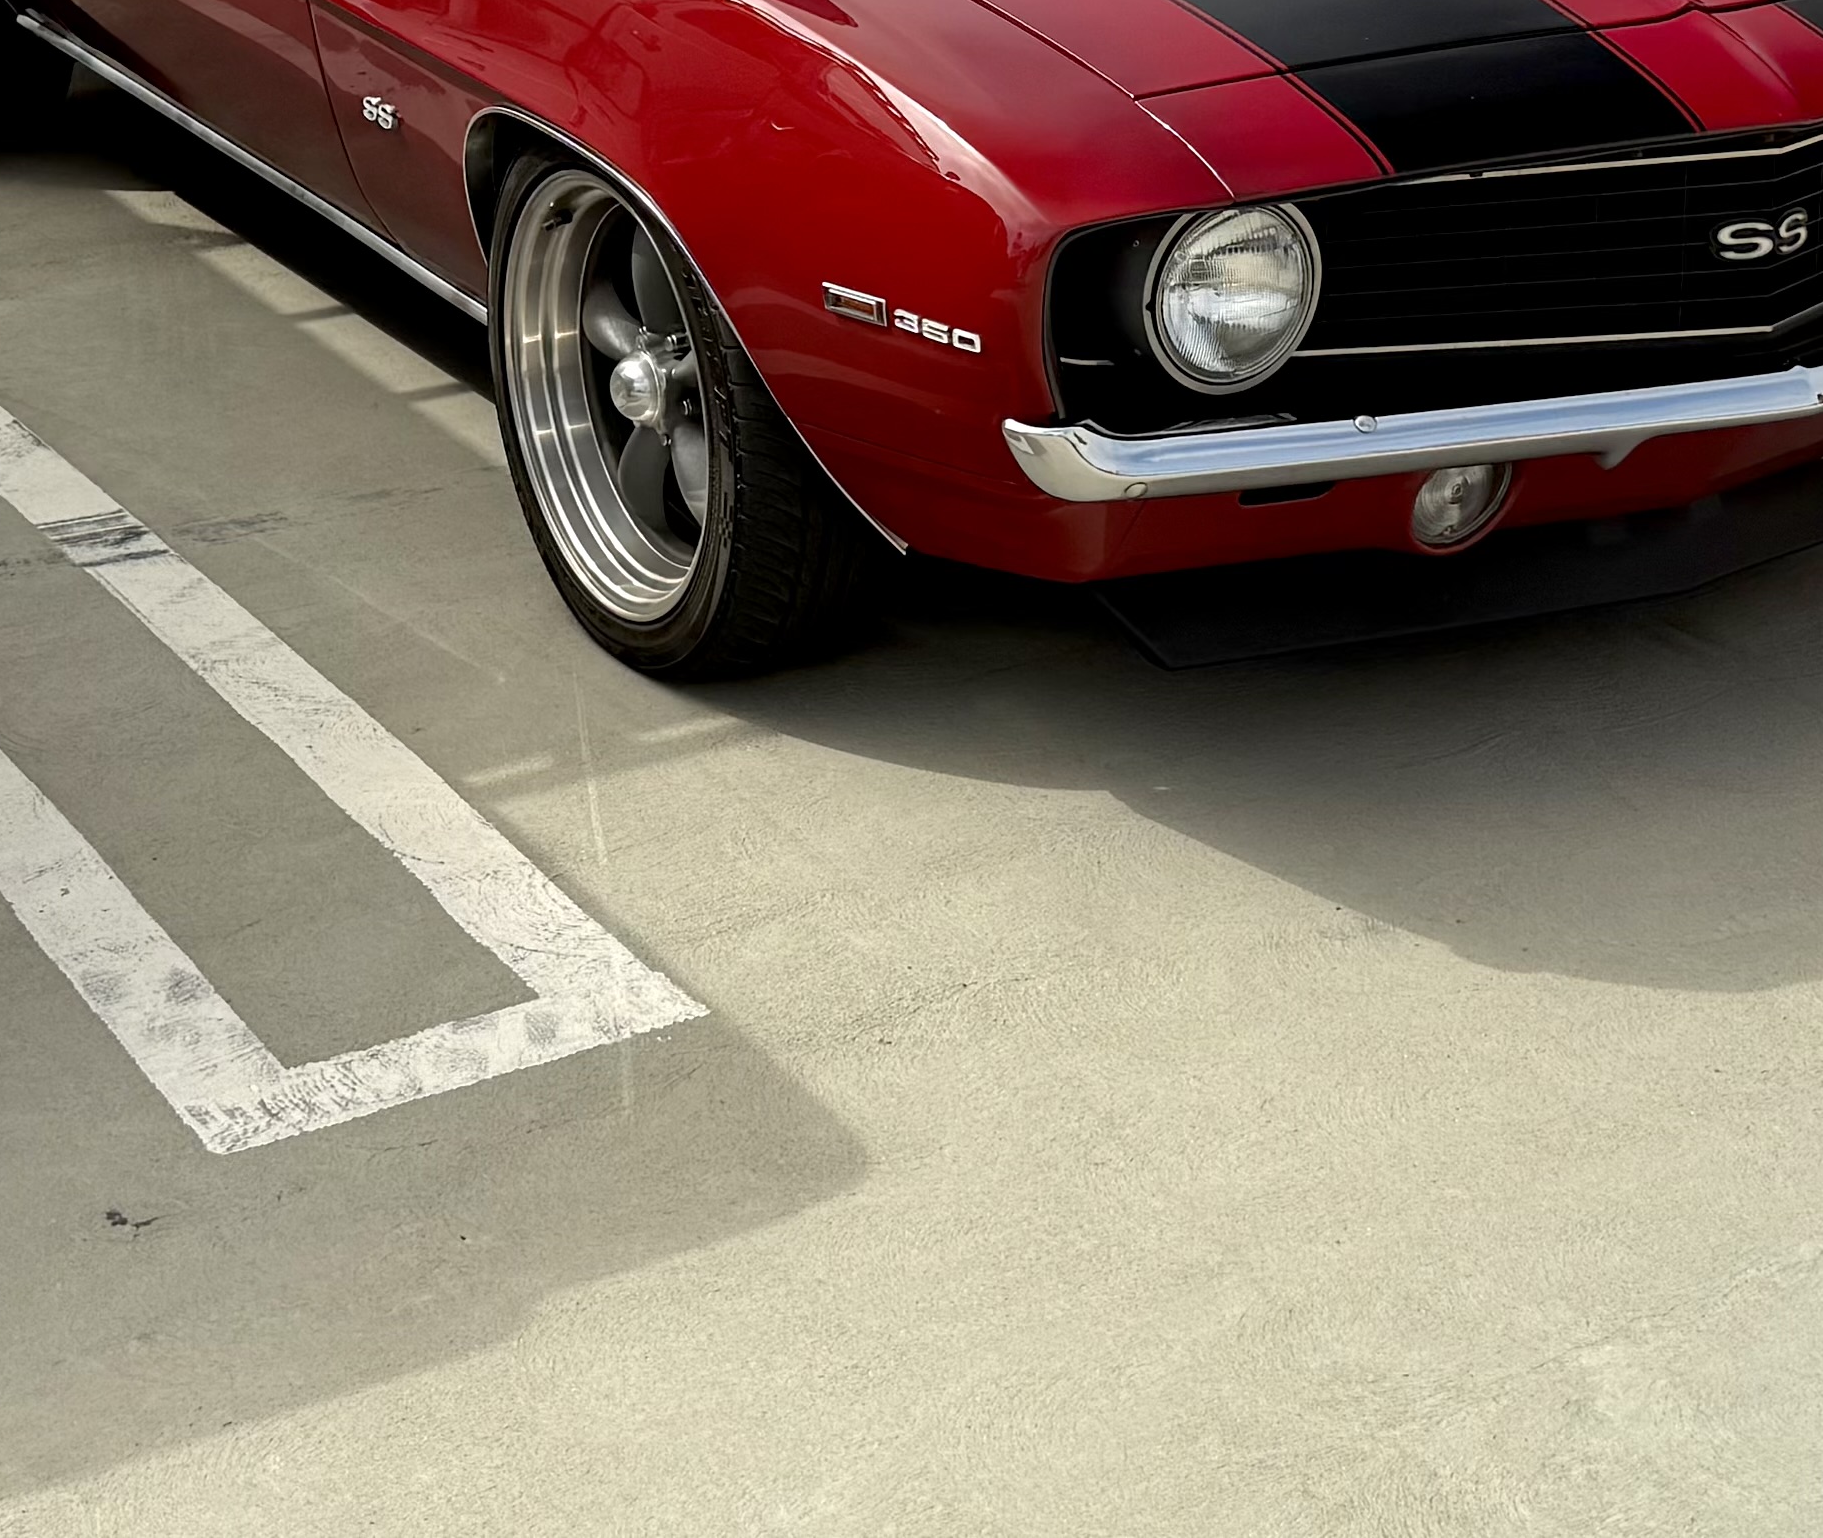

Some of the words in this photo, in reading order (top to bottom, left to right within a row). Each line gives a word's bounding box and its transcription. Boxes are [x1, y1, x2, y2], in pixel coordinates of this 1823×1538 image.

[362, 96, 396, 130] SS
[1717, 212, 1808, 260] SS
[893, 308, 981, 353] 350
